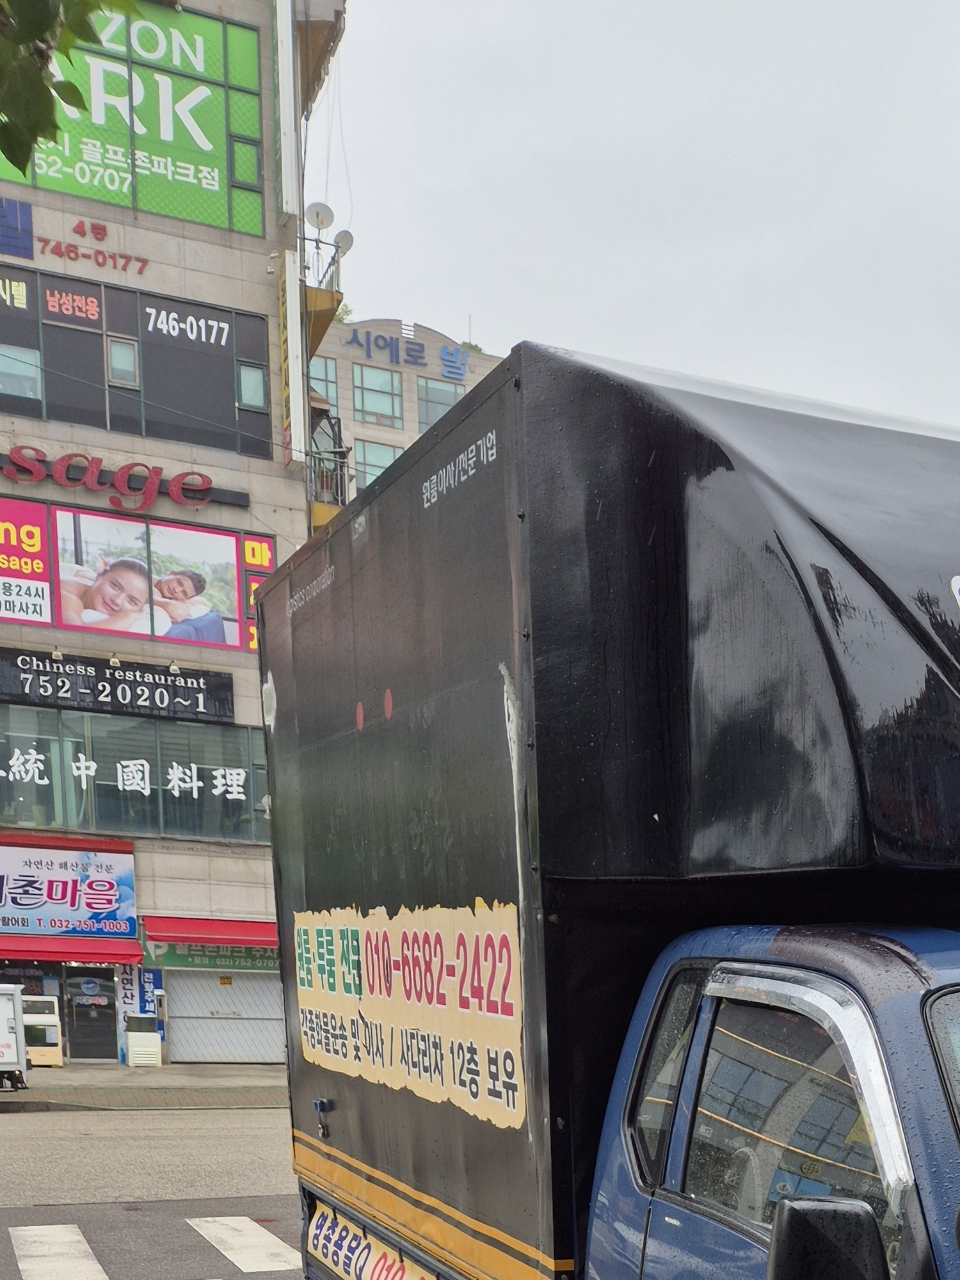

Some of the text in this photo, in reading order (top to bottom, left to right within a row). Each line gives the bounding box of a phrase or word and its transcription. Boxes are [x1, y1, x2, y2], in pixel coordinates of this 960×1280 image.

[79, 138, 220, 192] 골프존파크점
[72, 220, 108, 242] 4층
[37, 236, 149, 275] 746-0177
[46, 289, 100, 320] 남성전용
[145, 307, 230, 346] 746-0177
[346, 328, 470, 382] 시에로 빌
[2, 445, 213, 512] sage
[0, 600, 43, 617] 마사지
[17, 655, 207, 689] Chiness restaurant
[20, 673, 207, 713] 752-2020~1
[0, 748, 248, 801] 統中國料理
[22, 859, 55, 871] 자연산
[94, 863, 115, 874] 전문
[0, 874, 119, 912] 촌마을
[0, 916, 29, 928] 활어회
[49, 918, 129, 932] 032-751-1003
[234, 958, 280, 967] 752-0707
[365, 929, 515, 1018] 010-6682-2422
[300, 1008, 348, 1060] 각종화물운송
[400, 1029, 445, 1087] 사다리차
[450, 1040, 481, 1100] 12층
[487, 1048, 518, 1110] 보유
